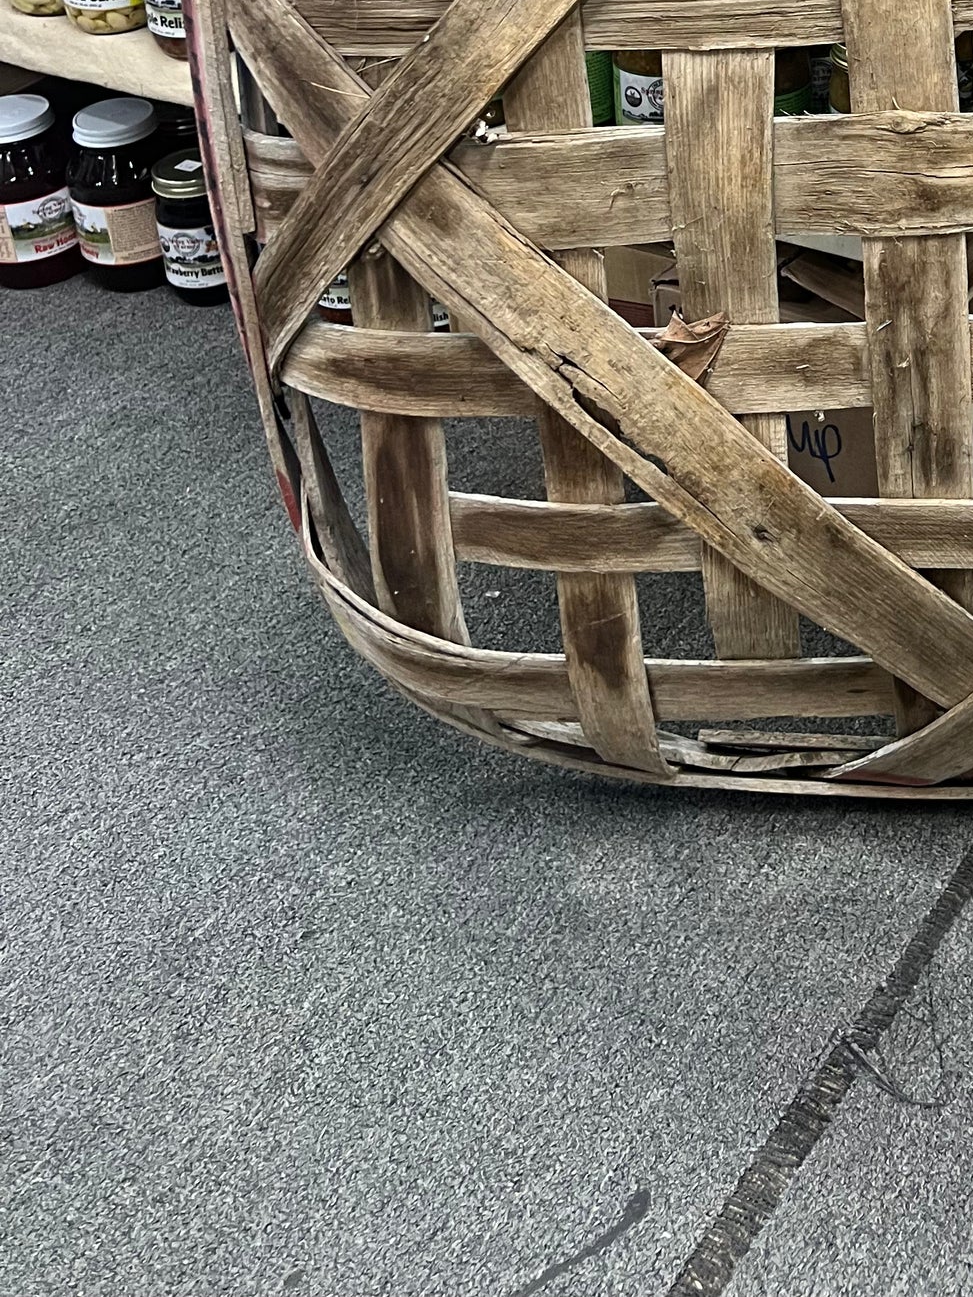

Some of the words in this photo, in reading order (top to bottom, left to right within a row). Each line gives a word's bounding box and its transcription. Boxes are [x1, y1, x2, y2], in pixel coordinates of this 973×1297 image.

[34, 240, 54, 254] Raw
[337, 296, 351, 305] Rel
[433, 313, 449, 322] lish
